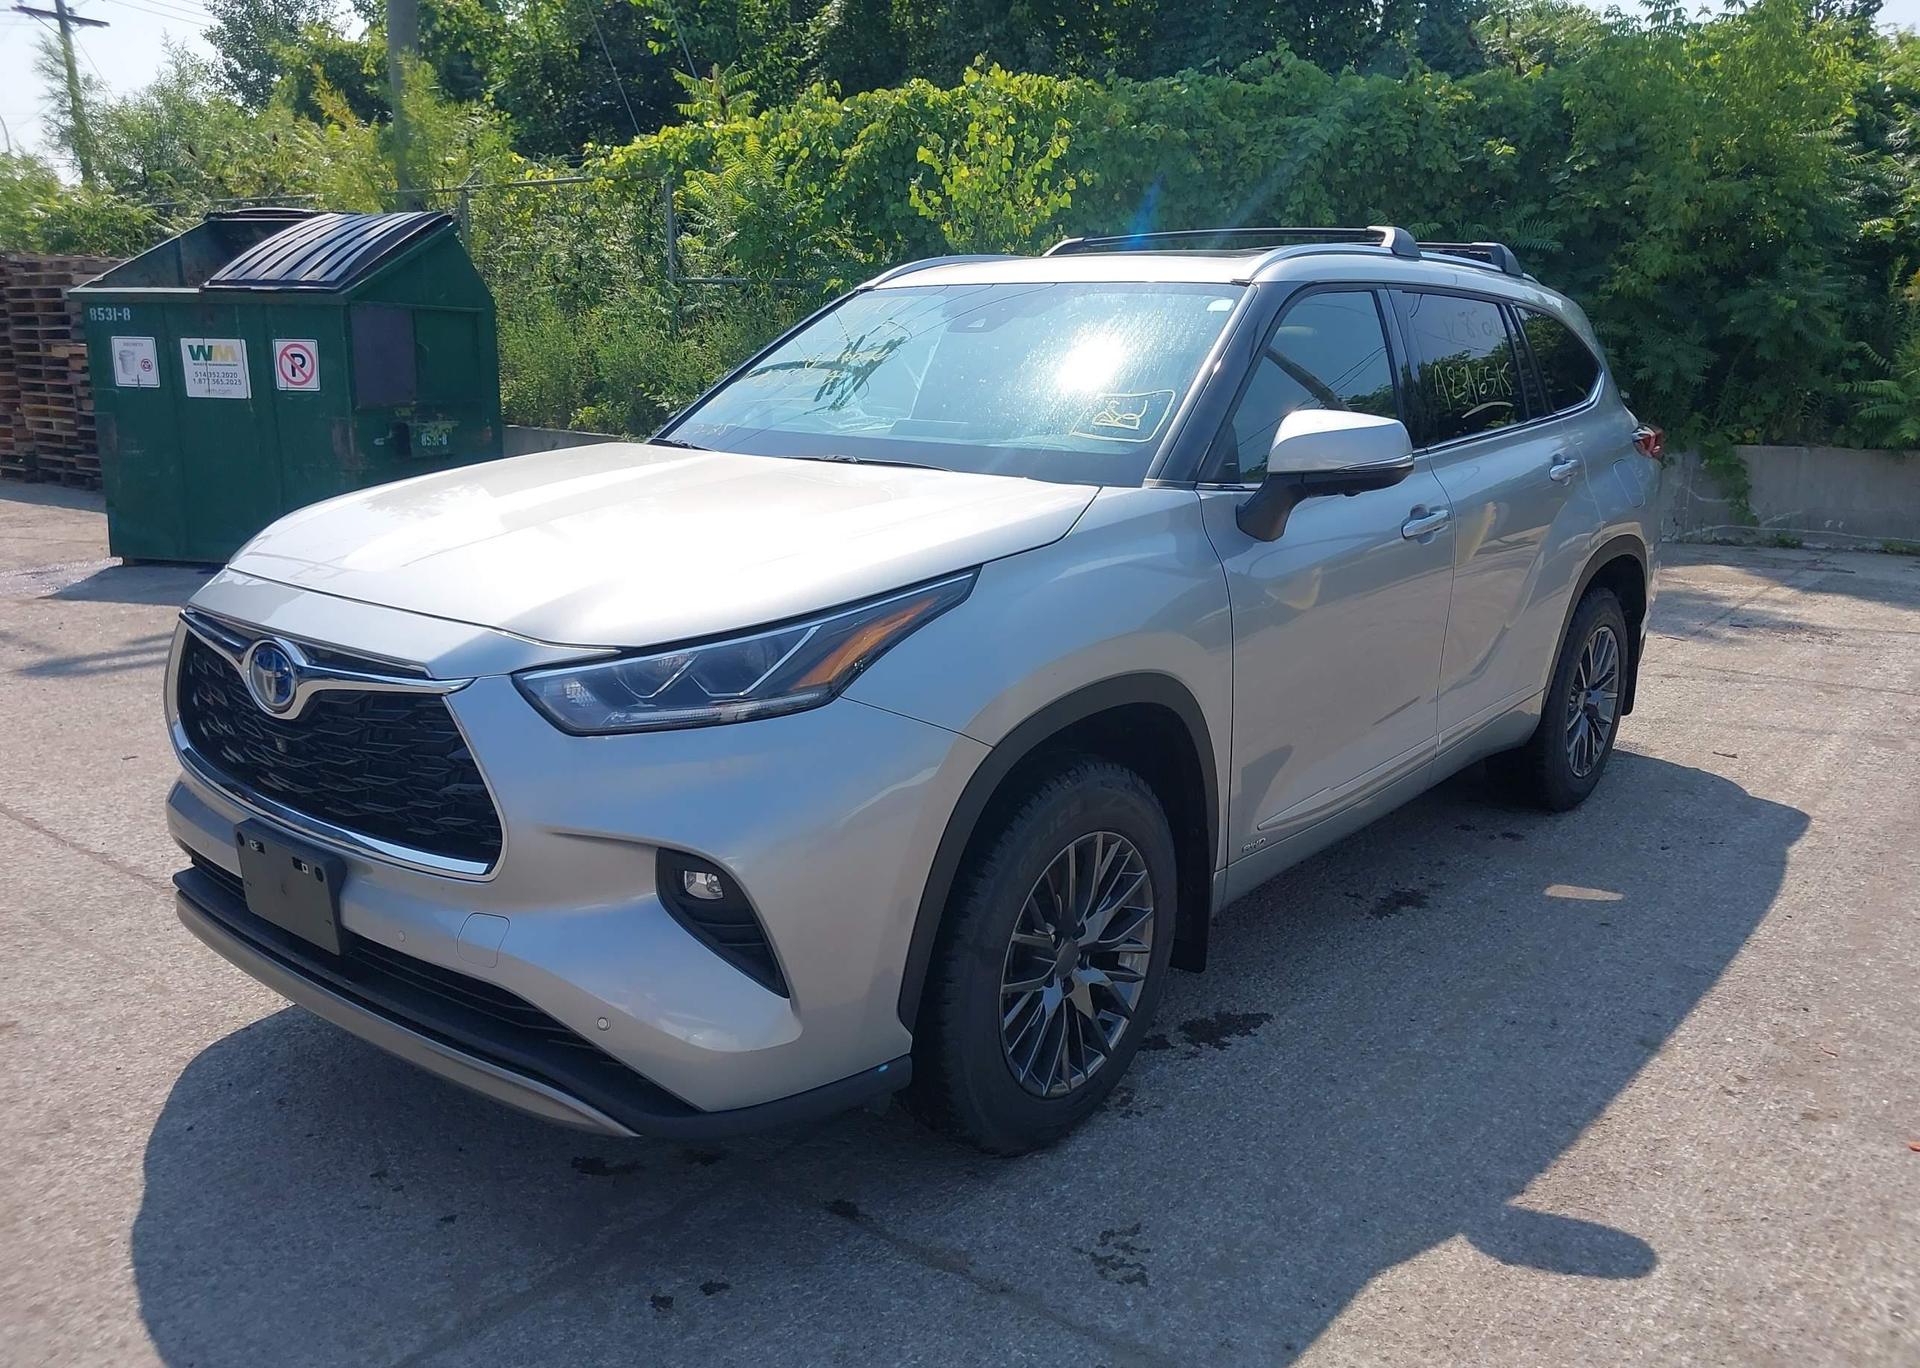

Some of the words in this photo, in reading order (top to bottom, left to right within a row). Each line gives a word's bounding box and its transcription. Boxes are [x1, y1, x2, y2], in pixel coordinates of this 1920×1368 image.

[89, 307, 131, 320] 8531-8
[187, 344, 237, 361] WM
[290, 353, 306, 378] P
[194, 371, 238, 379] 514352.2020
